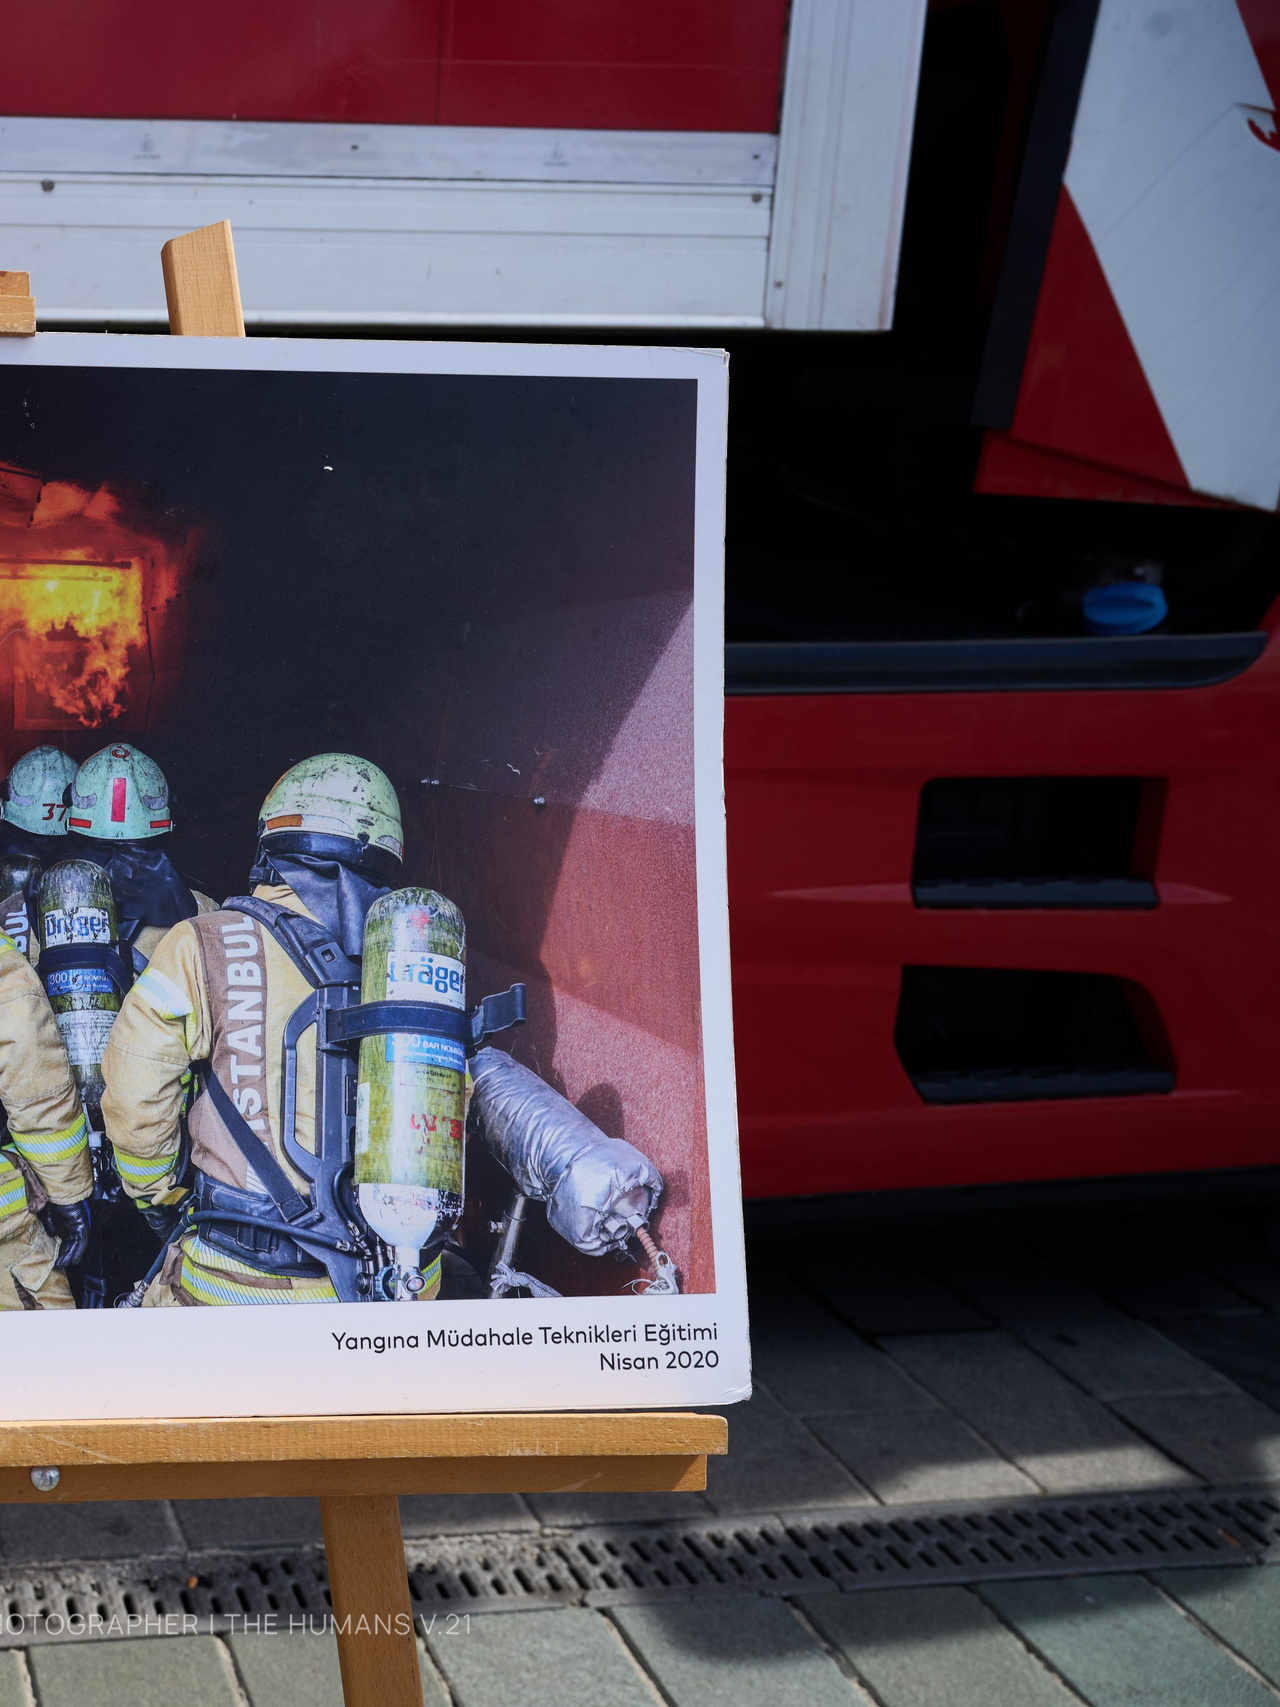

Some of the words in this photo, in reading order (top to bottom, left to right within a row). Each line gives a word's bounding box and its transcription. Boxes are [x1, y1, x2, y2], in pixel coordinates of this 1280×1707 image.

[42, 803, 68, 821] 37
[331, 1331, 419, 1354] Yangına
[427, 1326, 533, 1348] Müdahale
[538, 1324, 637, 1345] Teknikleri
[644, 1322, 718, 1346] Eğitimi
[599, 1352, 659, 1371] Nisan
[665, 1349, 719, 1369] 2020
